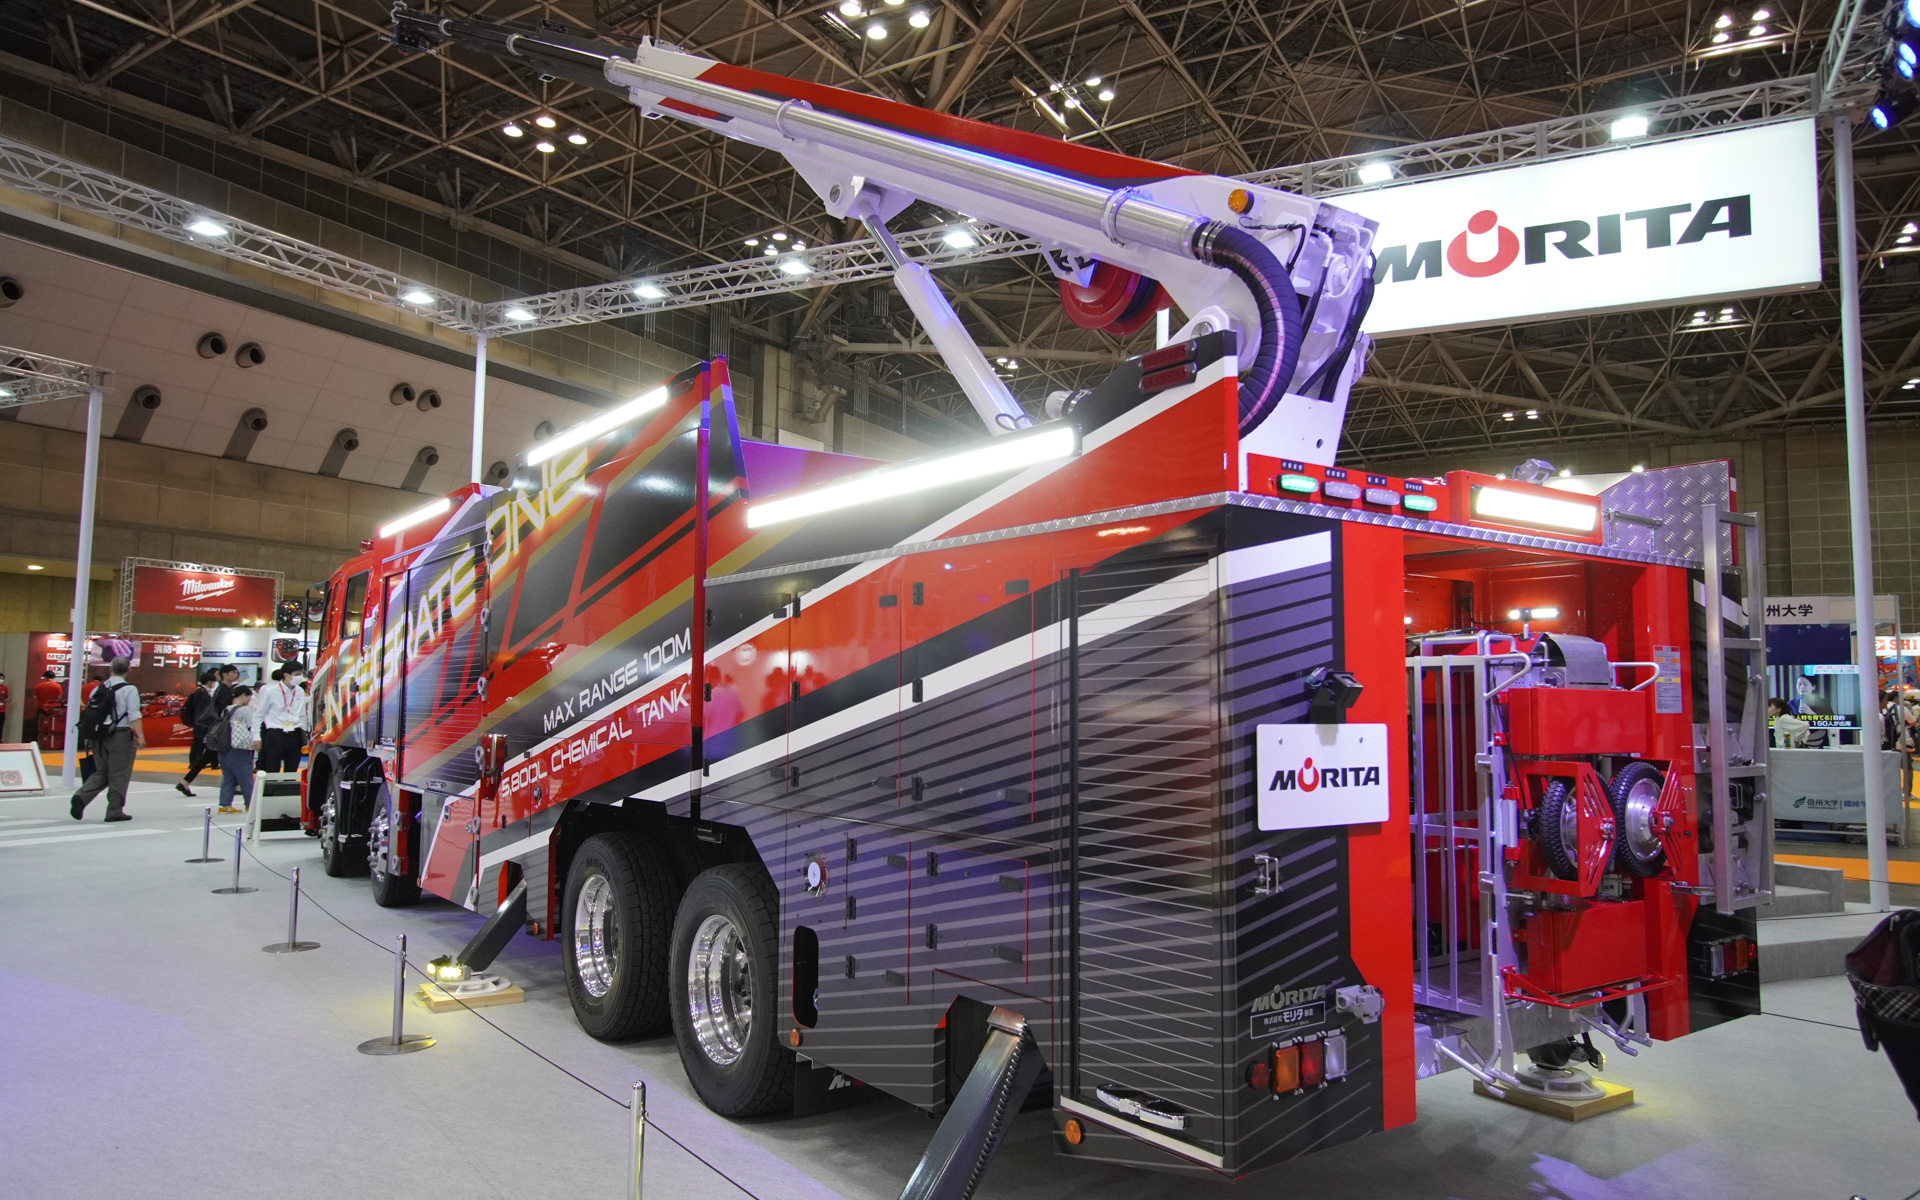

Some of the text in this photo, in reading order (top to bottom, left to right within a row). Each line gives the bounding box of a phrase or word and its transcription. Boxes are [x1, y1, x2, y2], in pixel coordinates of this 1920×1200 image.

[1374, 194, 1752, 285] MORITA
[180, 578, 236, 596] Milwaukee
[323, 446, 588, 736] INTEGRATE ONE
[1766, 604, 1813, 617] 州大学
[153, 644, 201, 655] 消防・防災工
[1889, 639, 1920, 650] SHI
[153, 656, 200, 668] コードレ
[543, 627, 691, 733] MAX RANGE 100M
[501, 682, 690, 798] 5,800L CHEMICAL TANK
[1268, 757, 1380, 793] MORITA
[1251, 984, 1326, 1013] MORITA
